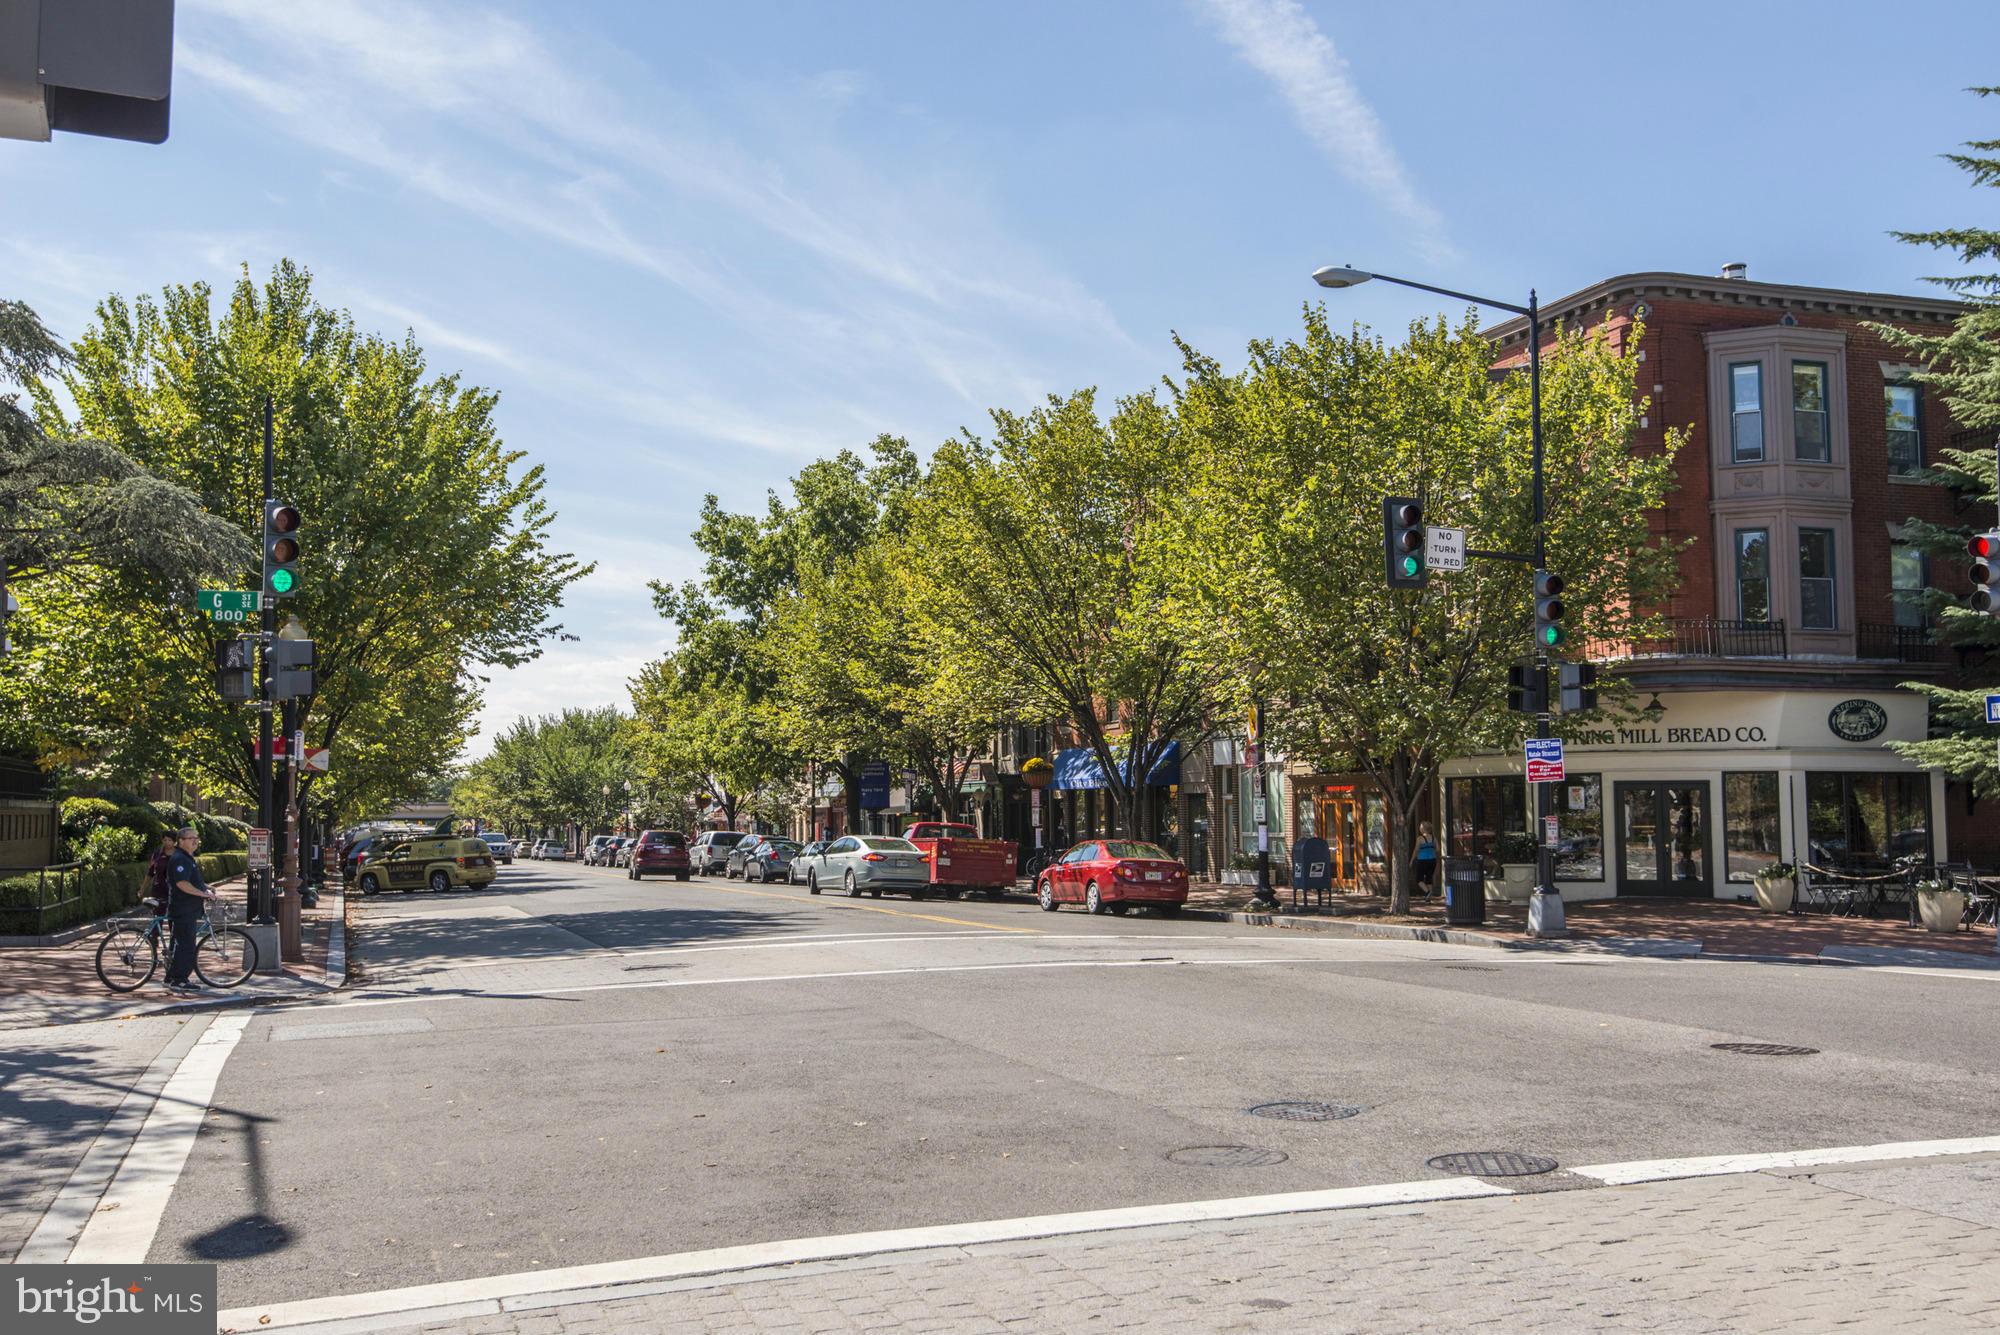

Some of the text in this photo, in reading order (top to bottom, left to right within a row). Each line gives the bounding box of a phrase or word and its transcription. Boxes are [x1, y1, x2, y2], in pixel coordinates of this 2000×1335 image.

[1438, 531, 1452, 541] NO
[1433, 544, 1457, 554] TURN
[1428, 556, 1460, 567] ON RED
[213, 593, 252, 608] G ST
[214, 609, 244, 621] 800
[1620, 728, 1662, 745] MILL
[1667, 727, 1731, 743] BREAD
[1735, 726, 1767, 743] CO.
[1536, 741, 1551, 749] ELECT
[1070, 779, 1086, 789] City
